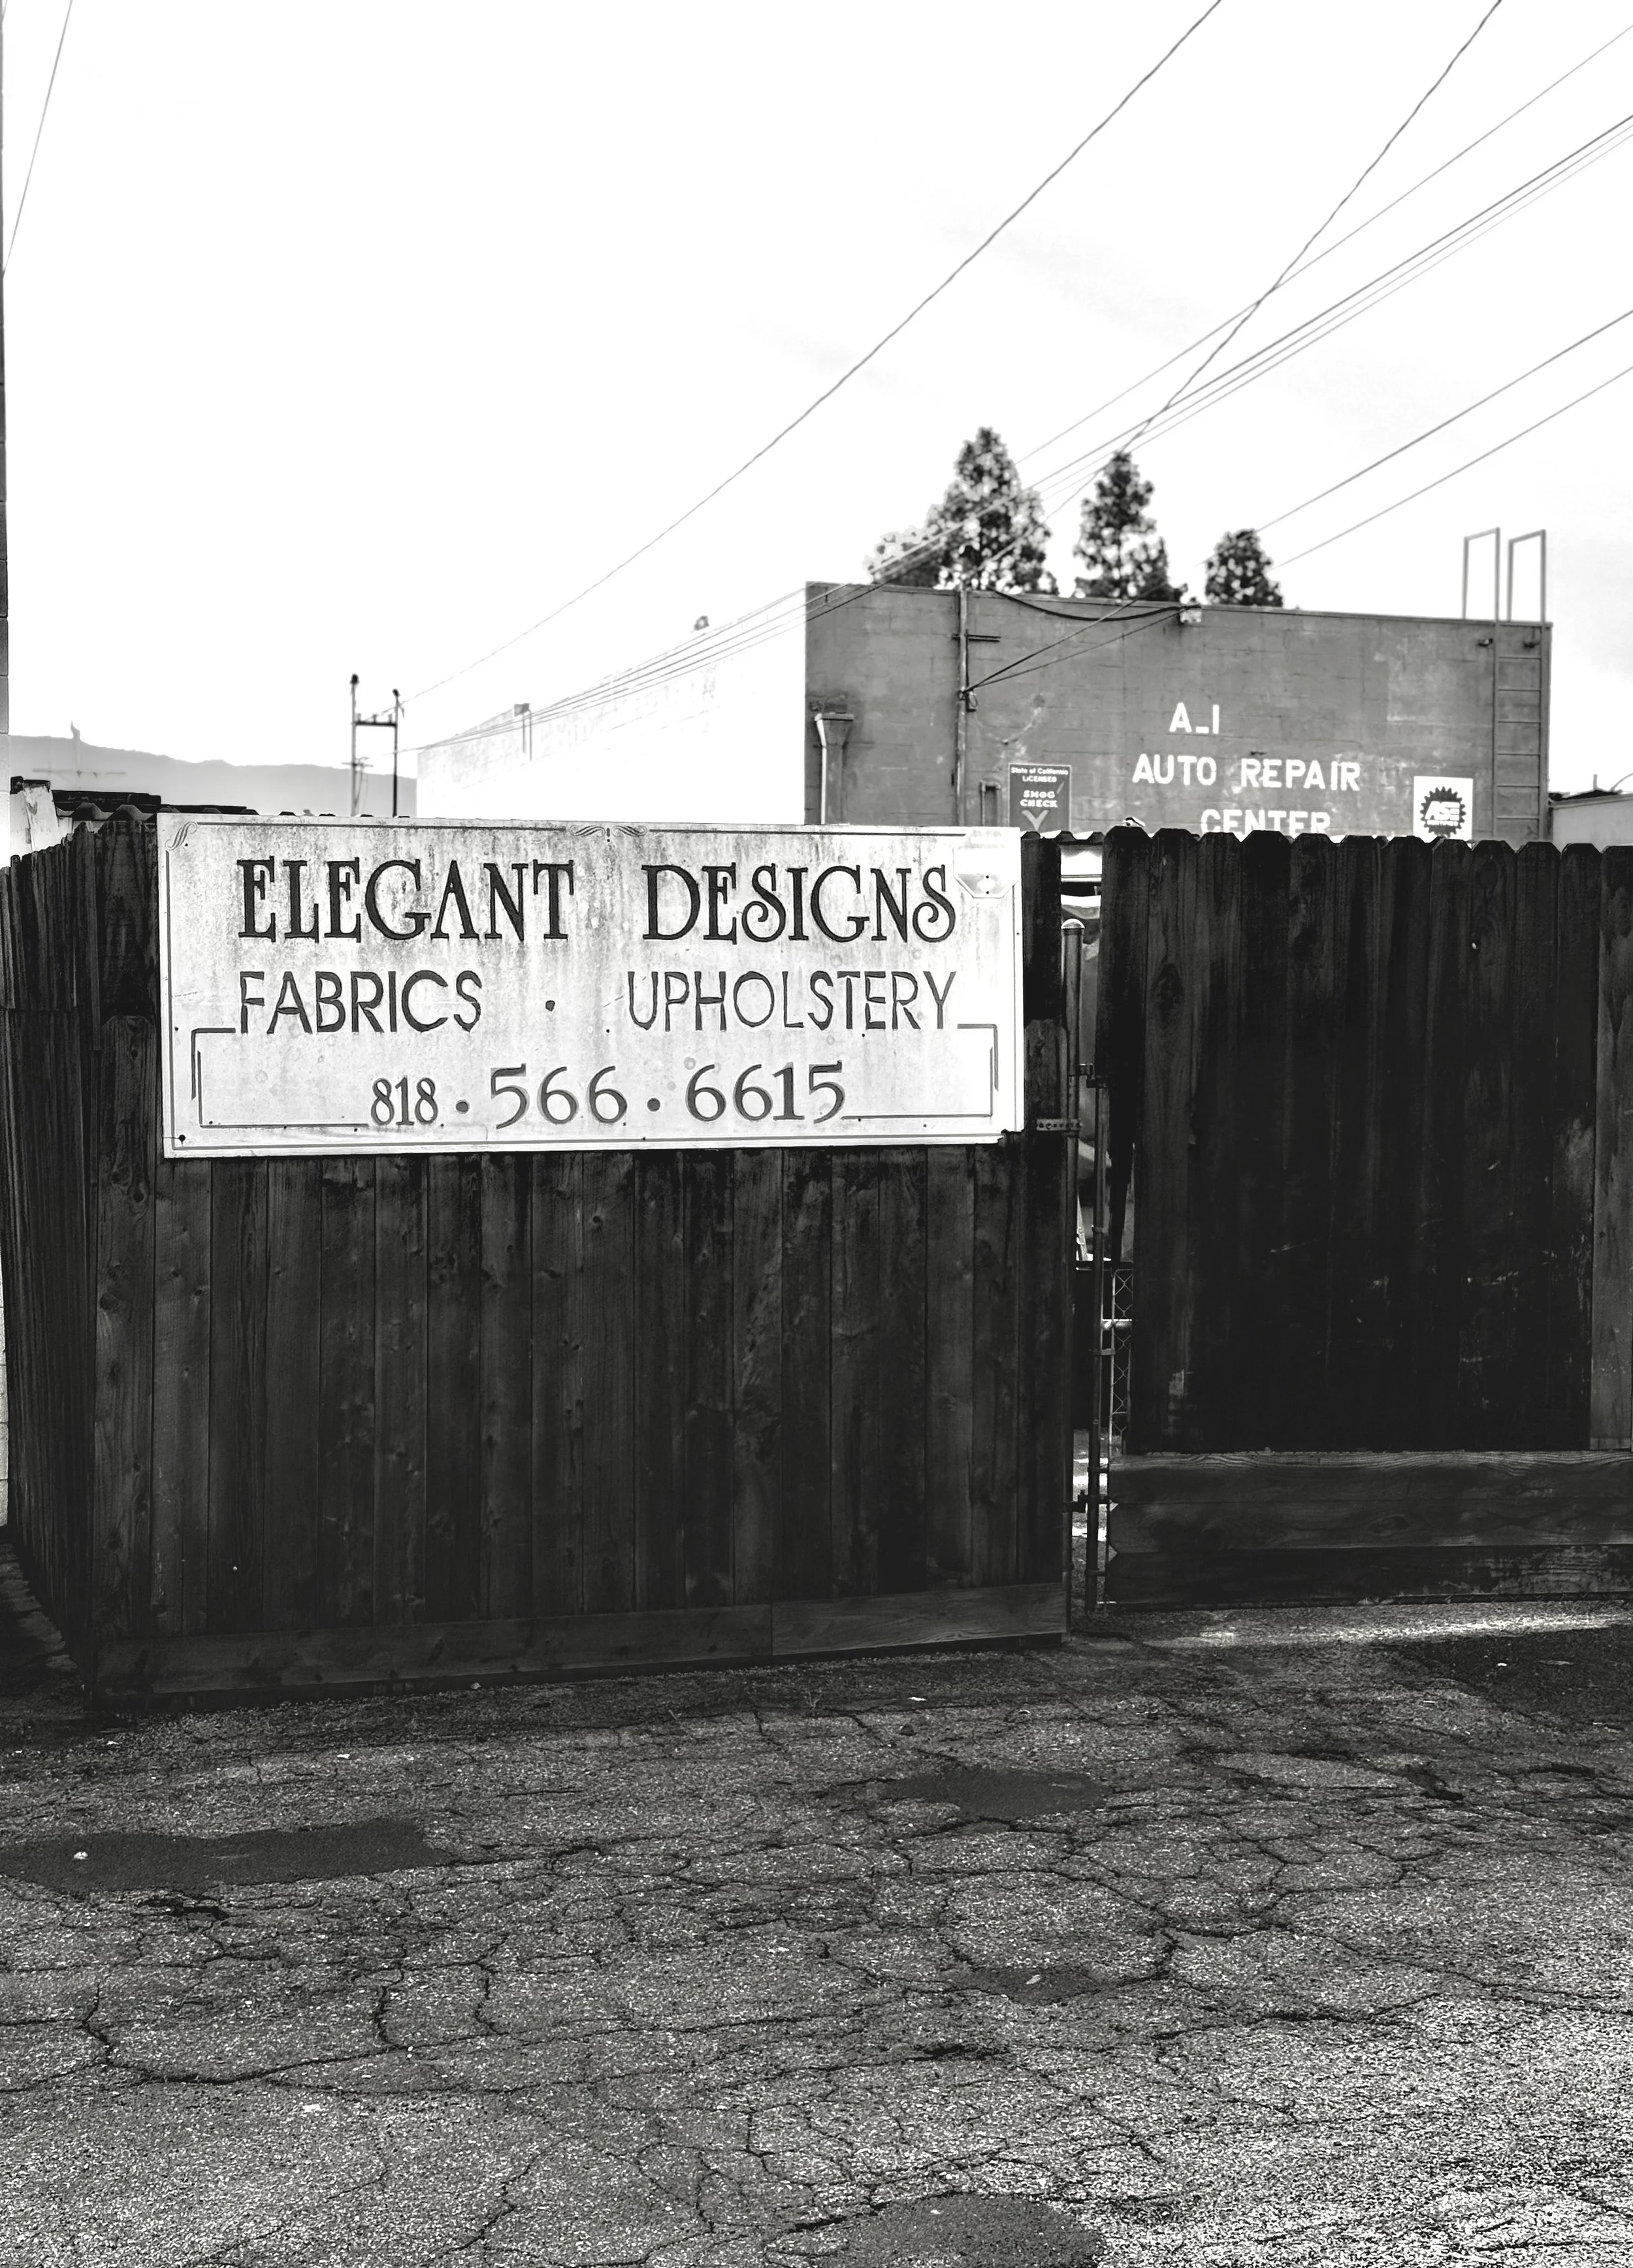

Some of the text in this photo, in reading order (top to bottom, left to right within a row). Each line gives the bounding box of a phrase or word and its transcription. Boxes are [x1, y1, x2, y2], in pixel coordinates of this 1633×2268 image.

[1132, 753, 1361, 791] AUTO REPAIR
[1020, 799, 1058, 808] CHECK
[1023, 790, 1056, 799] SMOG
[1425, 801, 1461, 820] ASE
[1201, 809, 1331, 836] CENTER
[237, 856, 956, 945] ELEGANT DESIGNS
[239, 969, 956, 1035] FABRICS UPHOLSTERY
[370, 1060, 845, 1129] 818 566 6615
